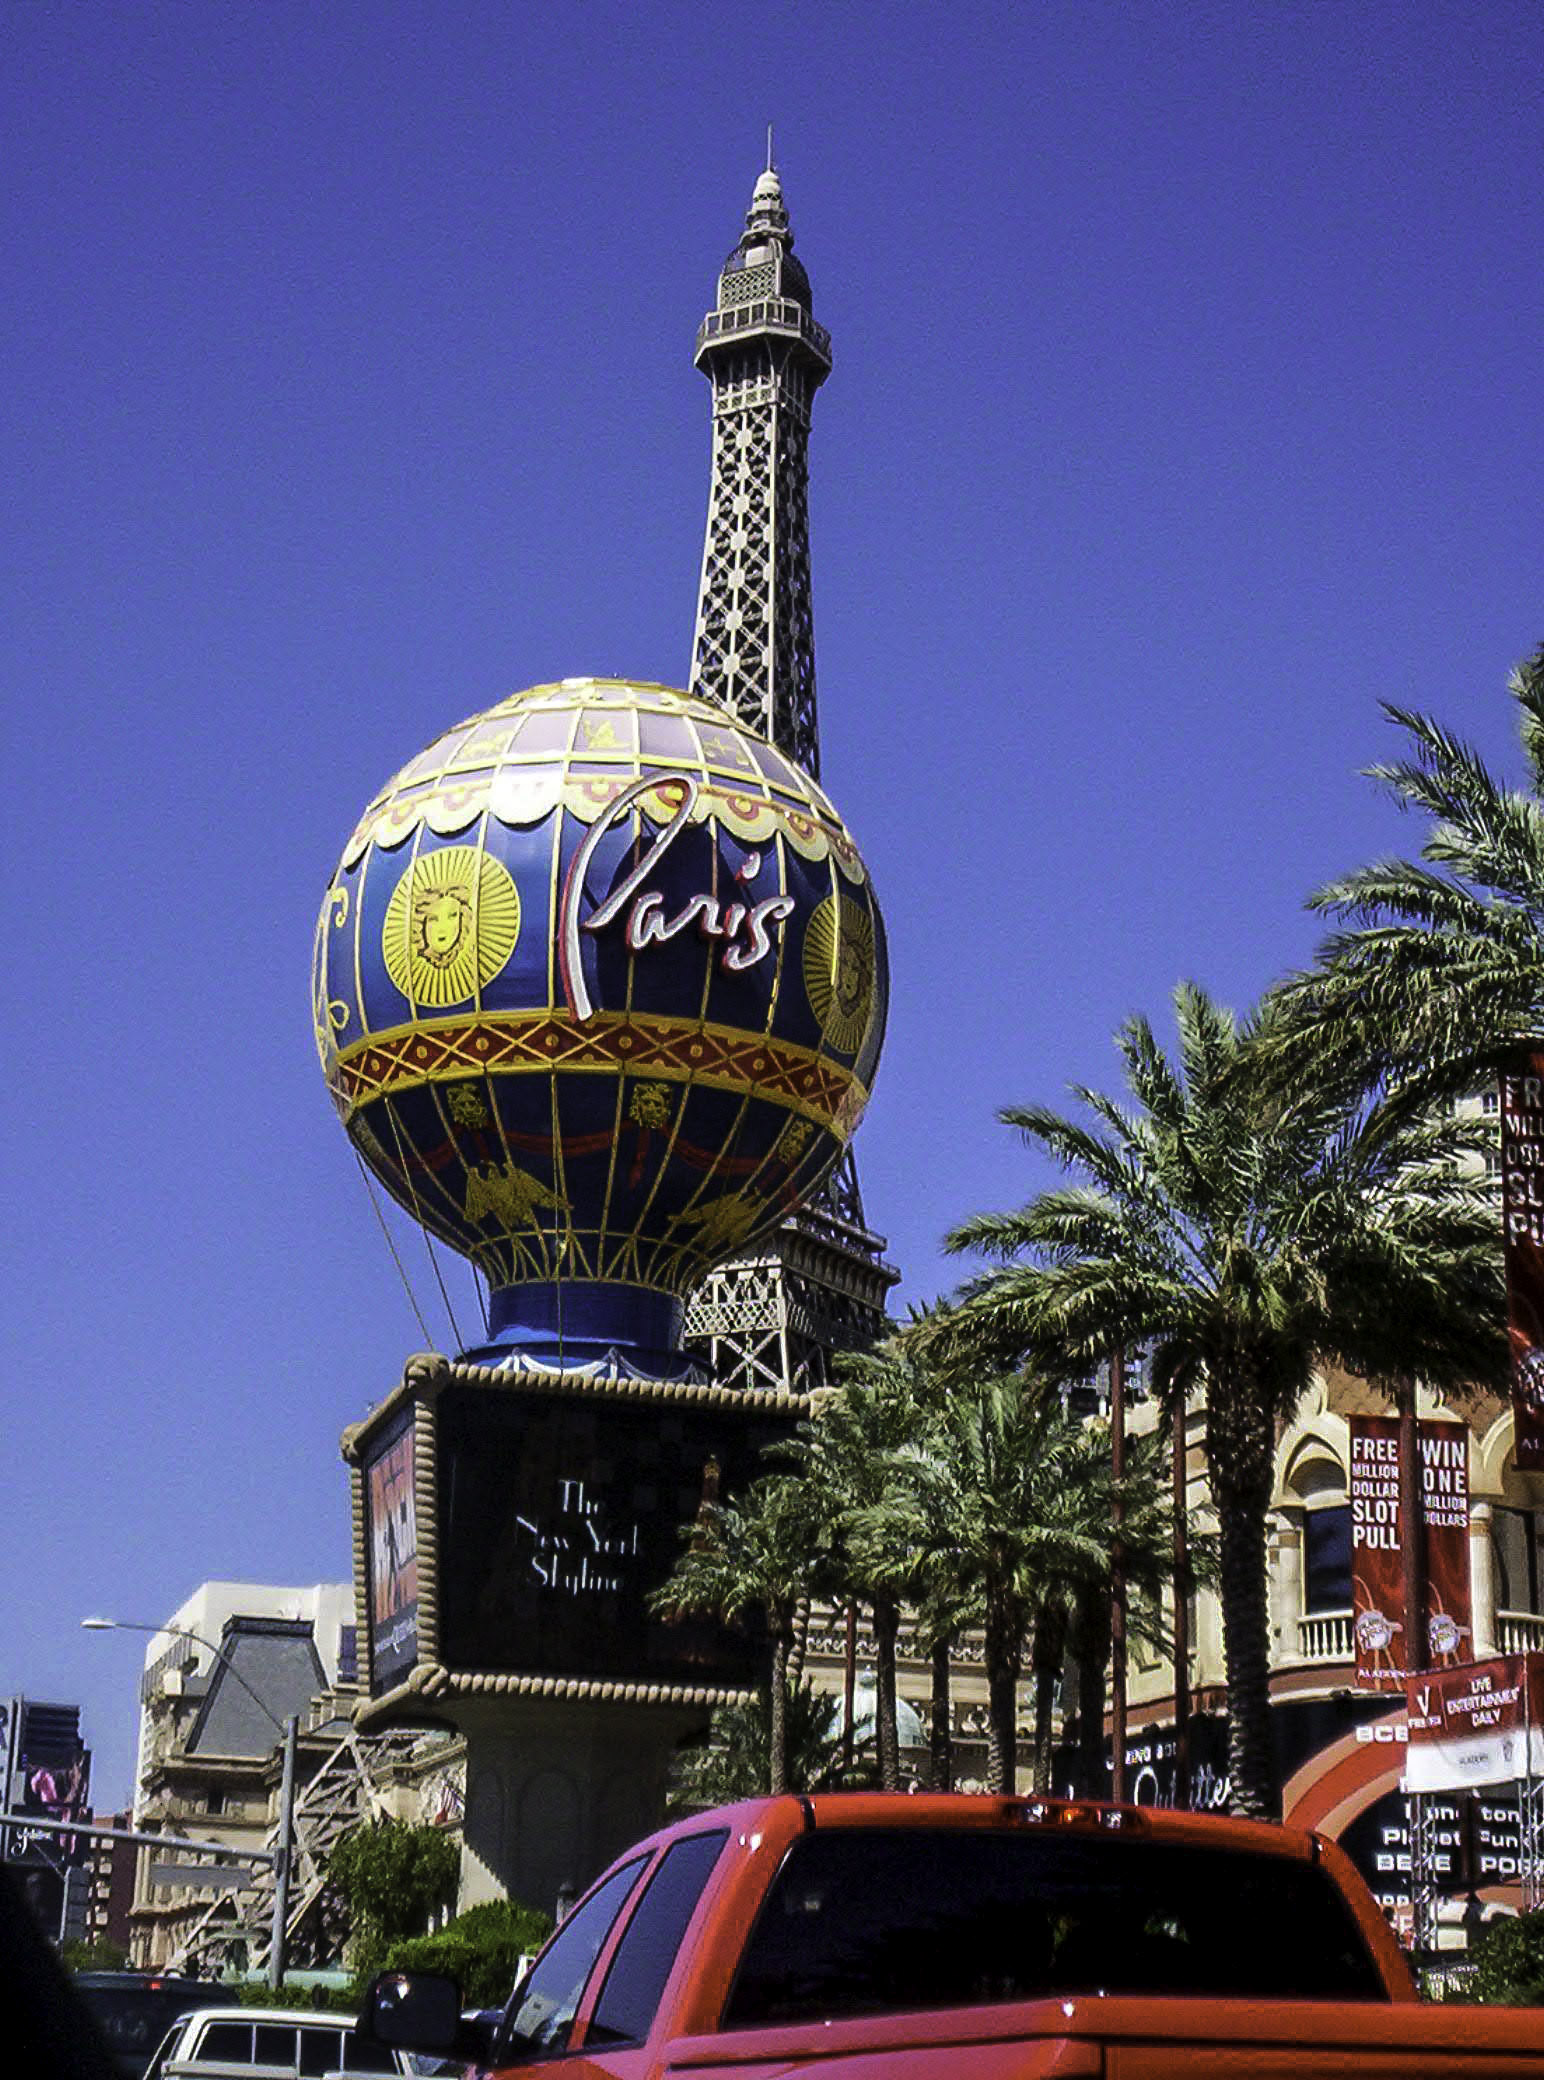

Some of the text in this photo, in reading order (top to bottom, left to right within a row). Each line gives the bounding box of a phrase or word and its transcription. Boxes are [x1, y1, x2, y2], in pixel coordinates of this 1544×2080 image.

[558, 768, 796, 1023] Paris
[1352, 1438, 1399, 1462] FREE
[1422, 1438, 1466, 1468] WIN
[1352, 1463, 1400, 1480] MILLION
[1423, 1467, 1467, 1494] ONE
[559, 1479, 601, 1515] The
[1352, 1480, 1400, 1499] DOLLAR
[1352, 1499, 1400, 1524] SLOT
[1423, 1494, 1468, 1512] MILLION
[1423, 1511, 1468, 1529] DOLLARS
[1352, 1524, 1401, 1551] PULL
